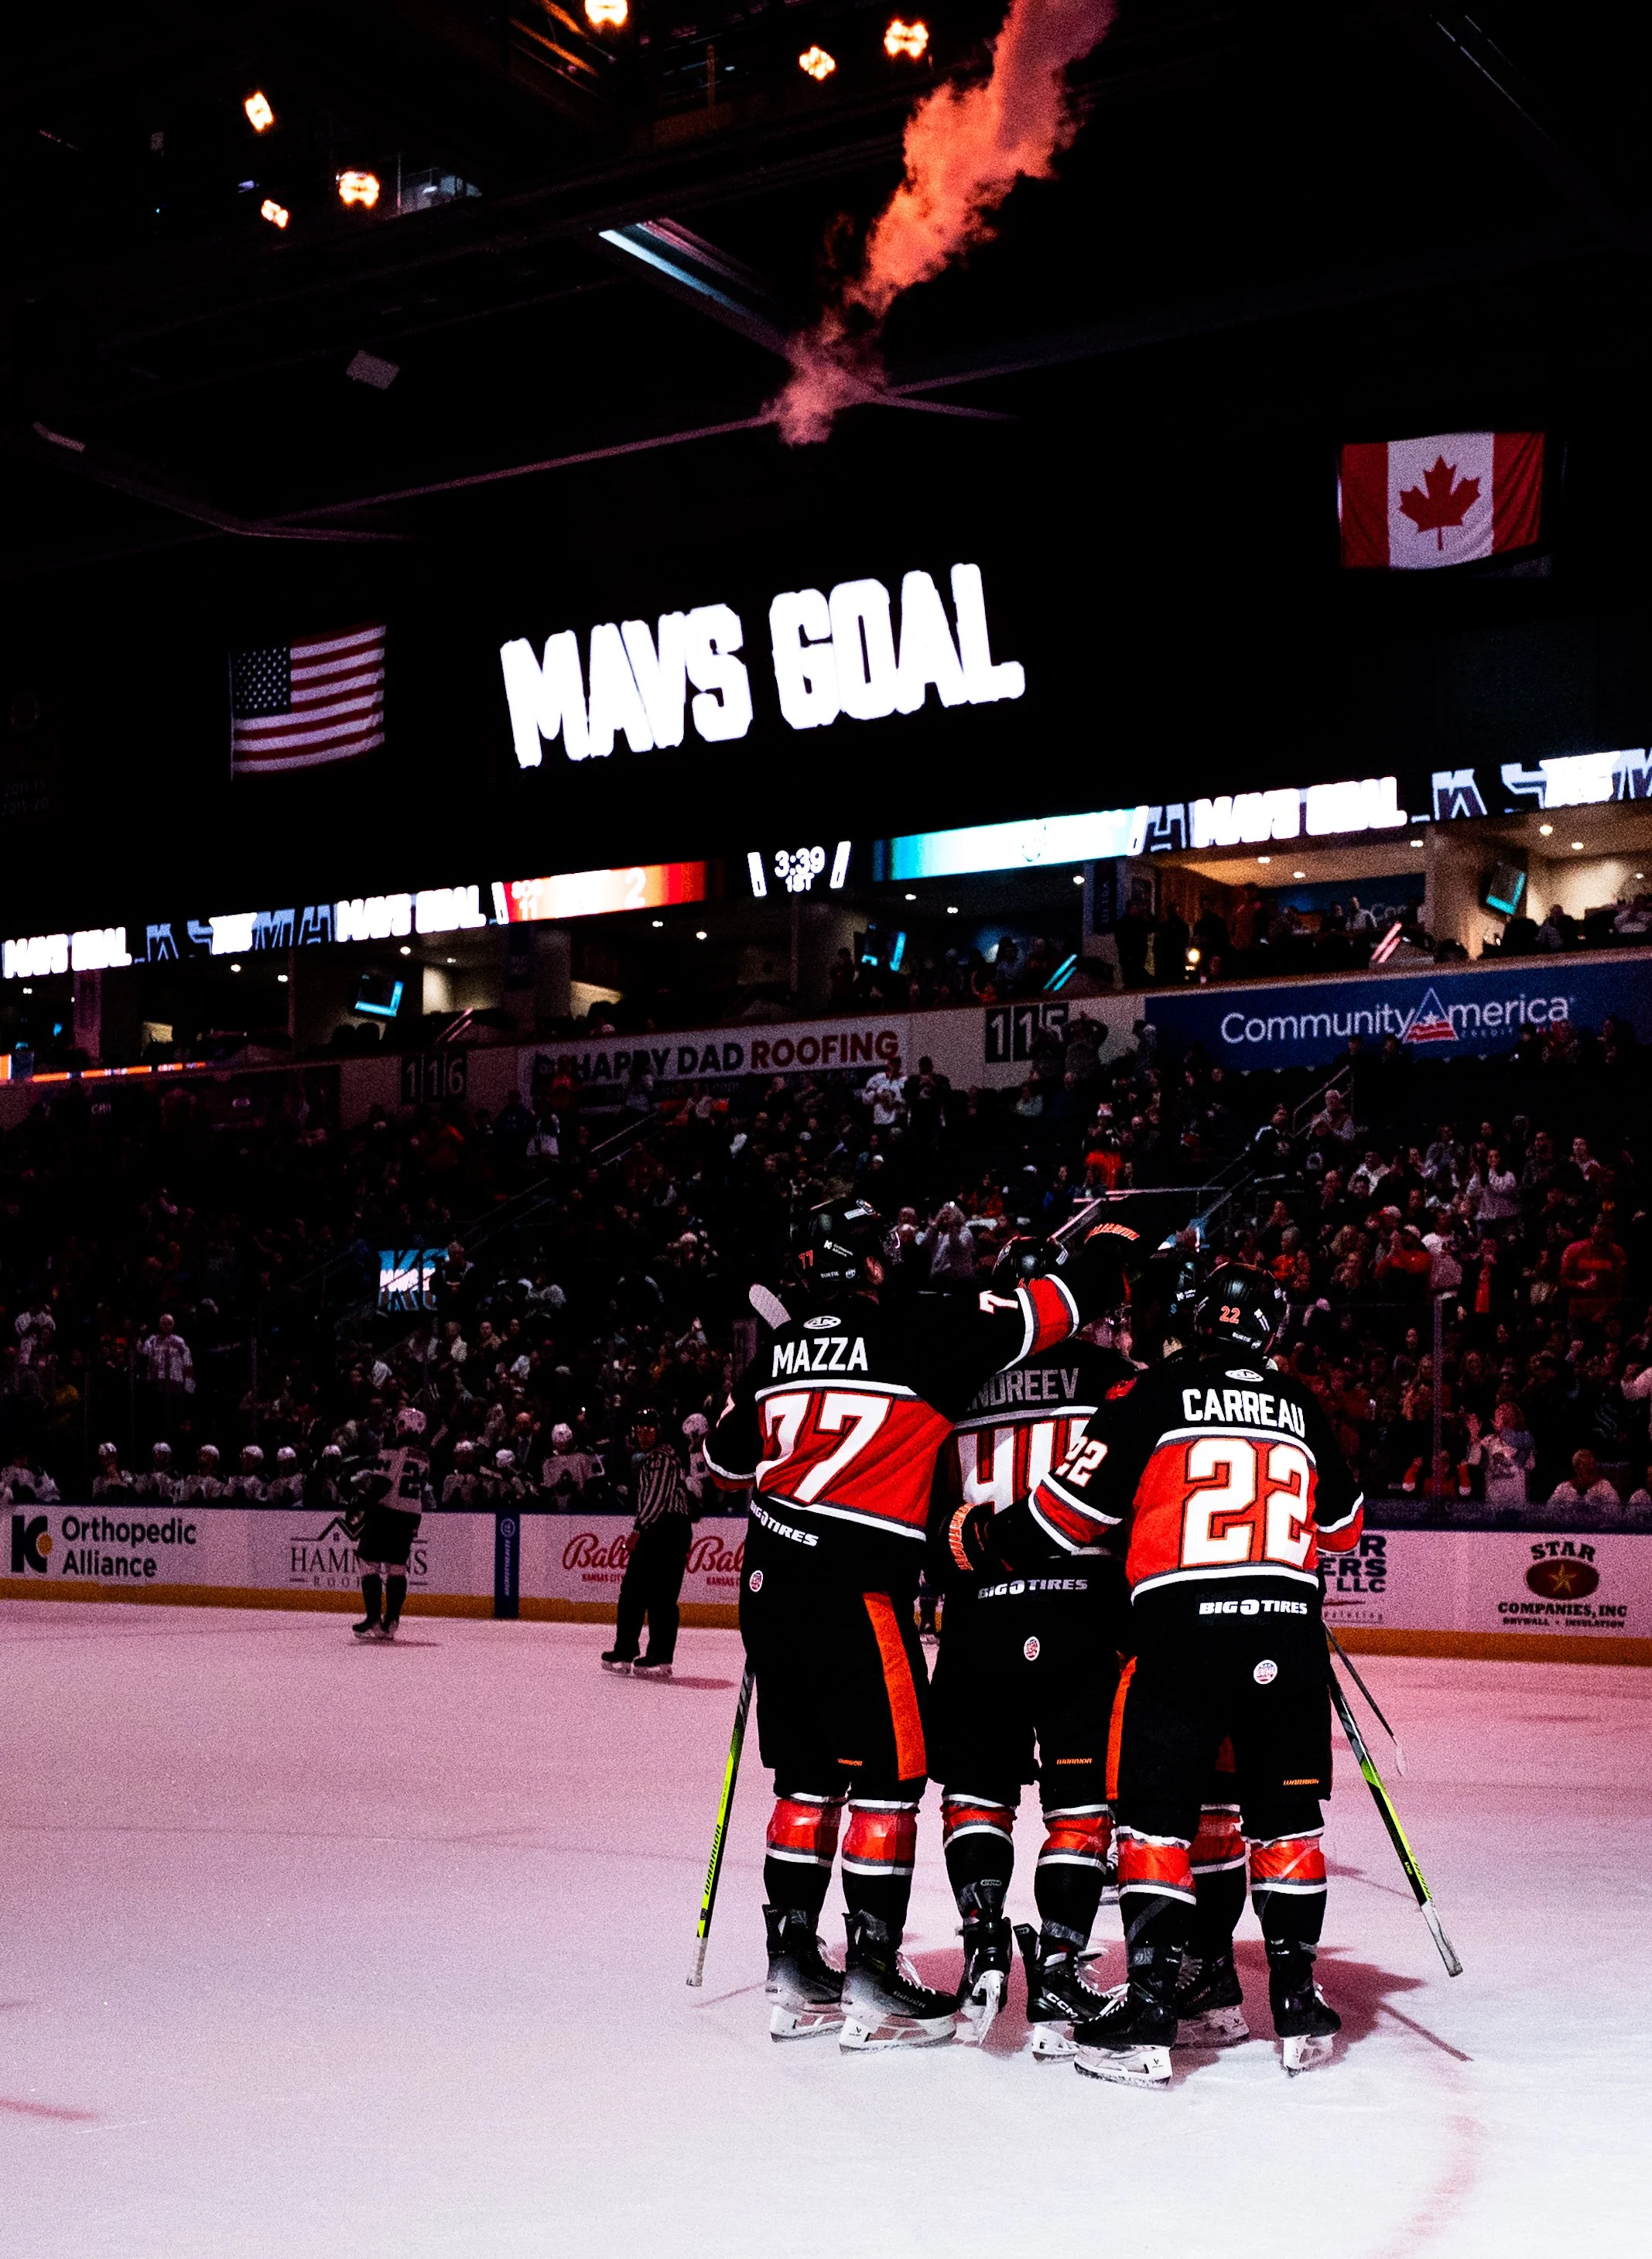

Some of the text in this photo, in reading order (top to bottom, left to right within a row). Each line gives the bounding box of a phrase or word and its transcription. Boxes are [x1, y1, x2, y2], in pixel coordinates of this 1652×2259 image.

[500, 563, 1026, 768] MAVS GOAL
[775, 846, 826, 878] 3:39
[624, 867, 647, 909] 2
[677, 1042, 744, 1074] DAD
[751, 1030, 898, 1069] ROOFING
[405, 1056, 465, 1099] 116
[798, 1249, 814, 1270] 77
[1219, 1305, 1241, 1325] 22
[771, 1337, 869, 1378] MAZZA
[966, 1367, 1079, 1412] NDREEV
[1182, 1388, 1305, 1439] CARREAU
[755, 1391, 894, 1505] 77
[1179, 1437, 1314, 1569] 22
[62, 1516, 197, 1548] Orthopedic
[768, 1517, 819, 1546] TIRES
[61, 1551, 157, 1577] Alliance
[1530, 1541, 1596, 1562] STAR
[977, 1583, 1007, 1600] BIG
[1027, 1579, 1088, 1590] TIRES
[1336, 1578, 1386, 1593] LLC
[1199, 1601, 1239, 1615] BIG
[1260, 1600, 1308, 1615] TIRES
[1503, 1617, 1550, 1626] DRYWALL
[1046, 1992, 1079, 2019] CCM
